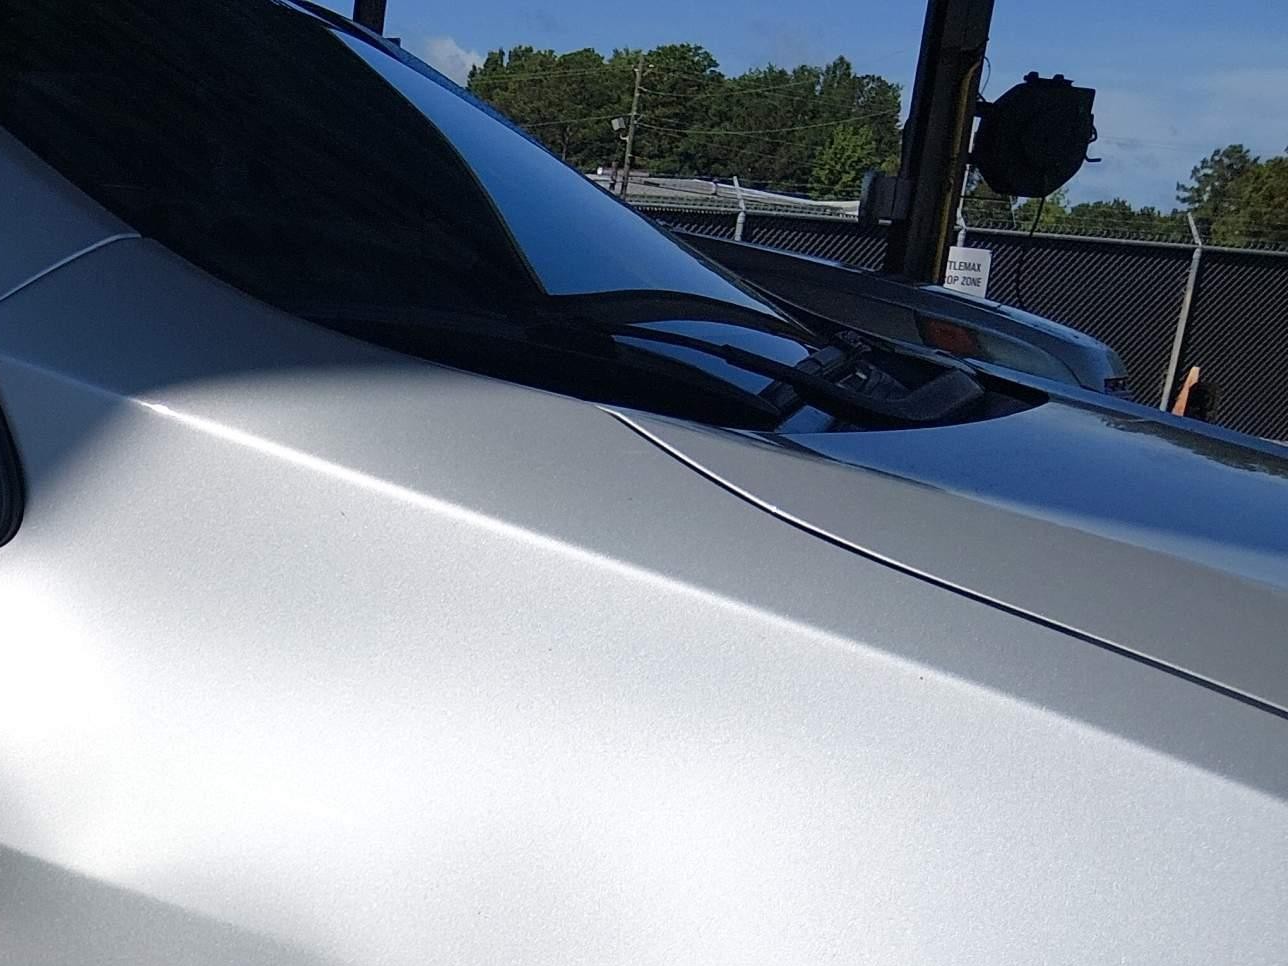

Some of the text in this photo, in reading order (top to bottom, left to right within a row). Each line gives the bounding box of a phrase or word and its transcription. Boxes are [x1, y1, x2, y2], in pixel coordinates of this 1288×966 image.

[948, 260, 981, 272] TLEMAX
[946, 275, 982, 287] OP ZONE
